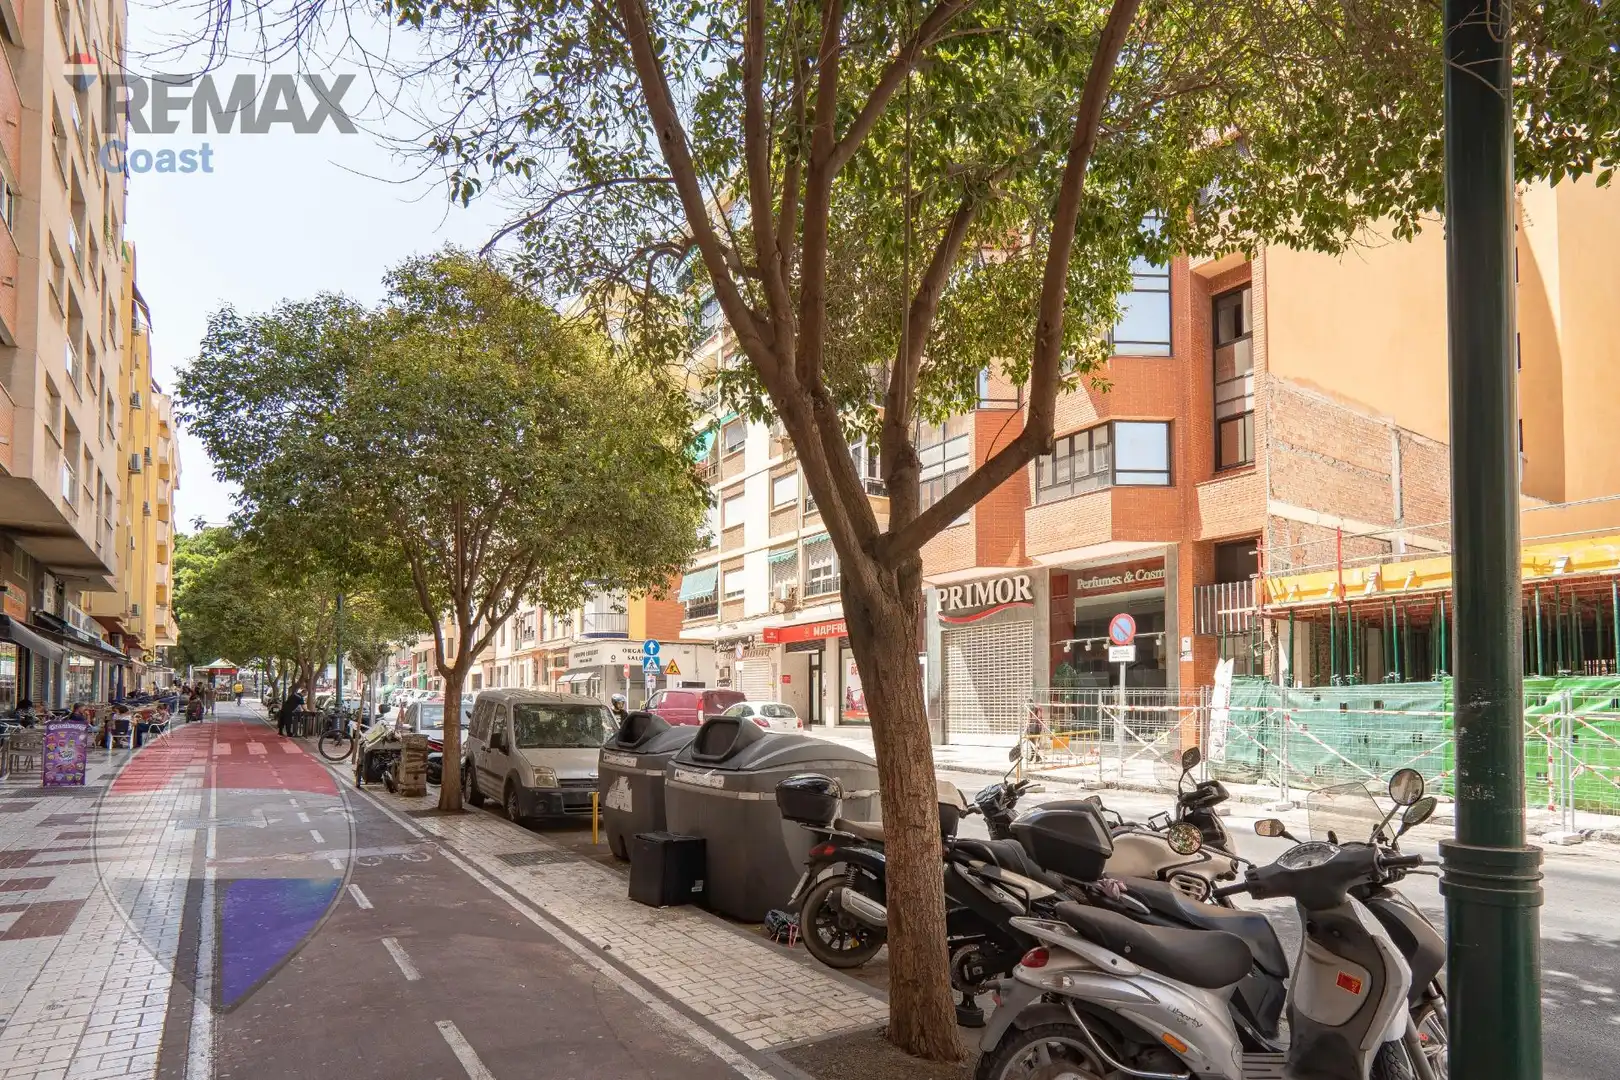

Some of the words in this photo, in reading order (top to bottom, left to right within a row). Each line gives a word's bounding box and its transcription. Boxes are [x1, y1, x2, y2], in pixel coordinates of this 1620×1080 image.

[935, 575, 1033, 612] PRIMOR
[1077, 576, 1123, 589] Perfumes
[1124, 571, 1135, 583] &
